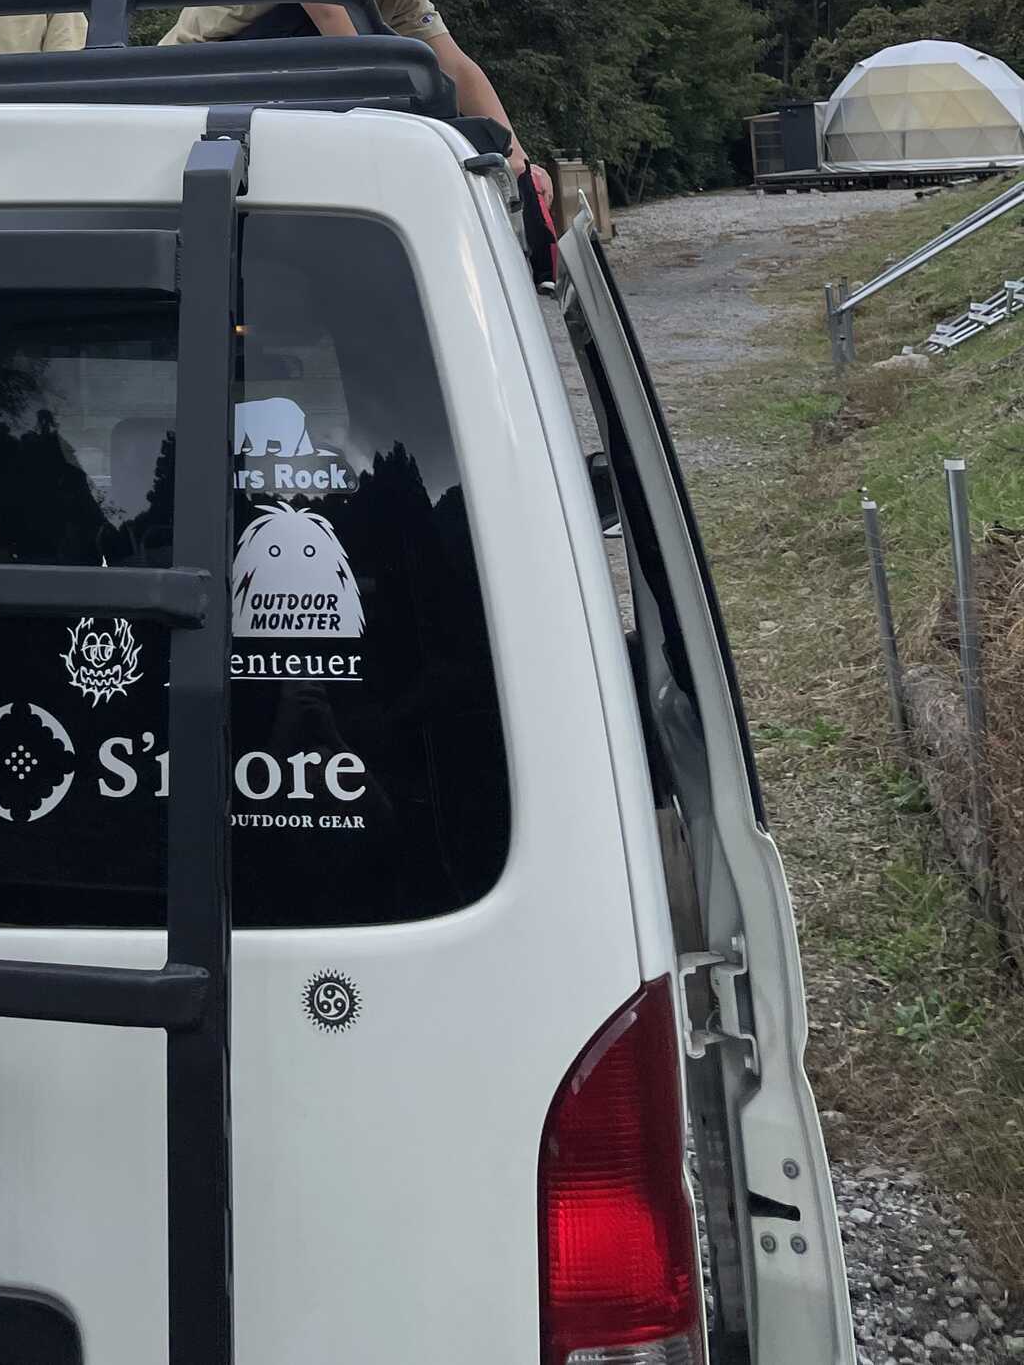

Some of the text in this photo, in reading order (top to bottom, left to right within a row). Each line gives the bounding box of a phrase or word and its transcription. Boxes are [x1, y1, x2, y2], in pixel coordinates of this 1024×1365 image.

[274, 463, 347, 489] Rock
[251, 593, 338, 611] OUTDOOR
[250, 613, 341, 631] MONSTER
[230, 652, 362, 675] enteuer
[98, 731, 366, 801] S'ore
[318, 815, 366, 828] GEAR
